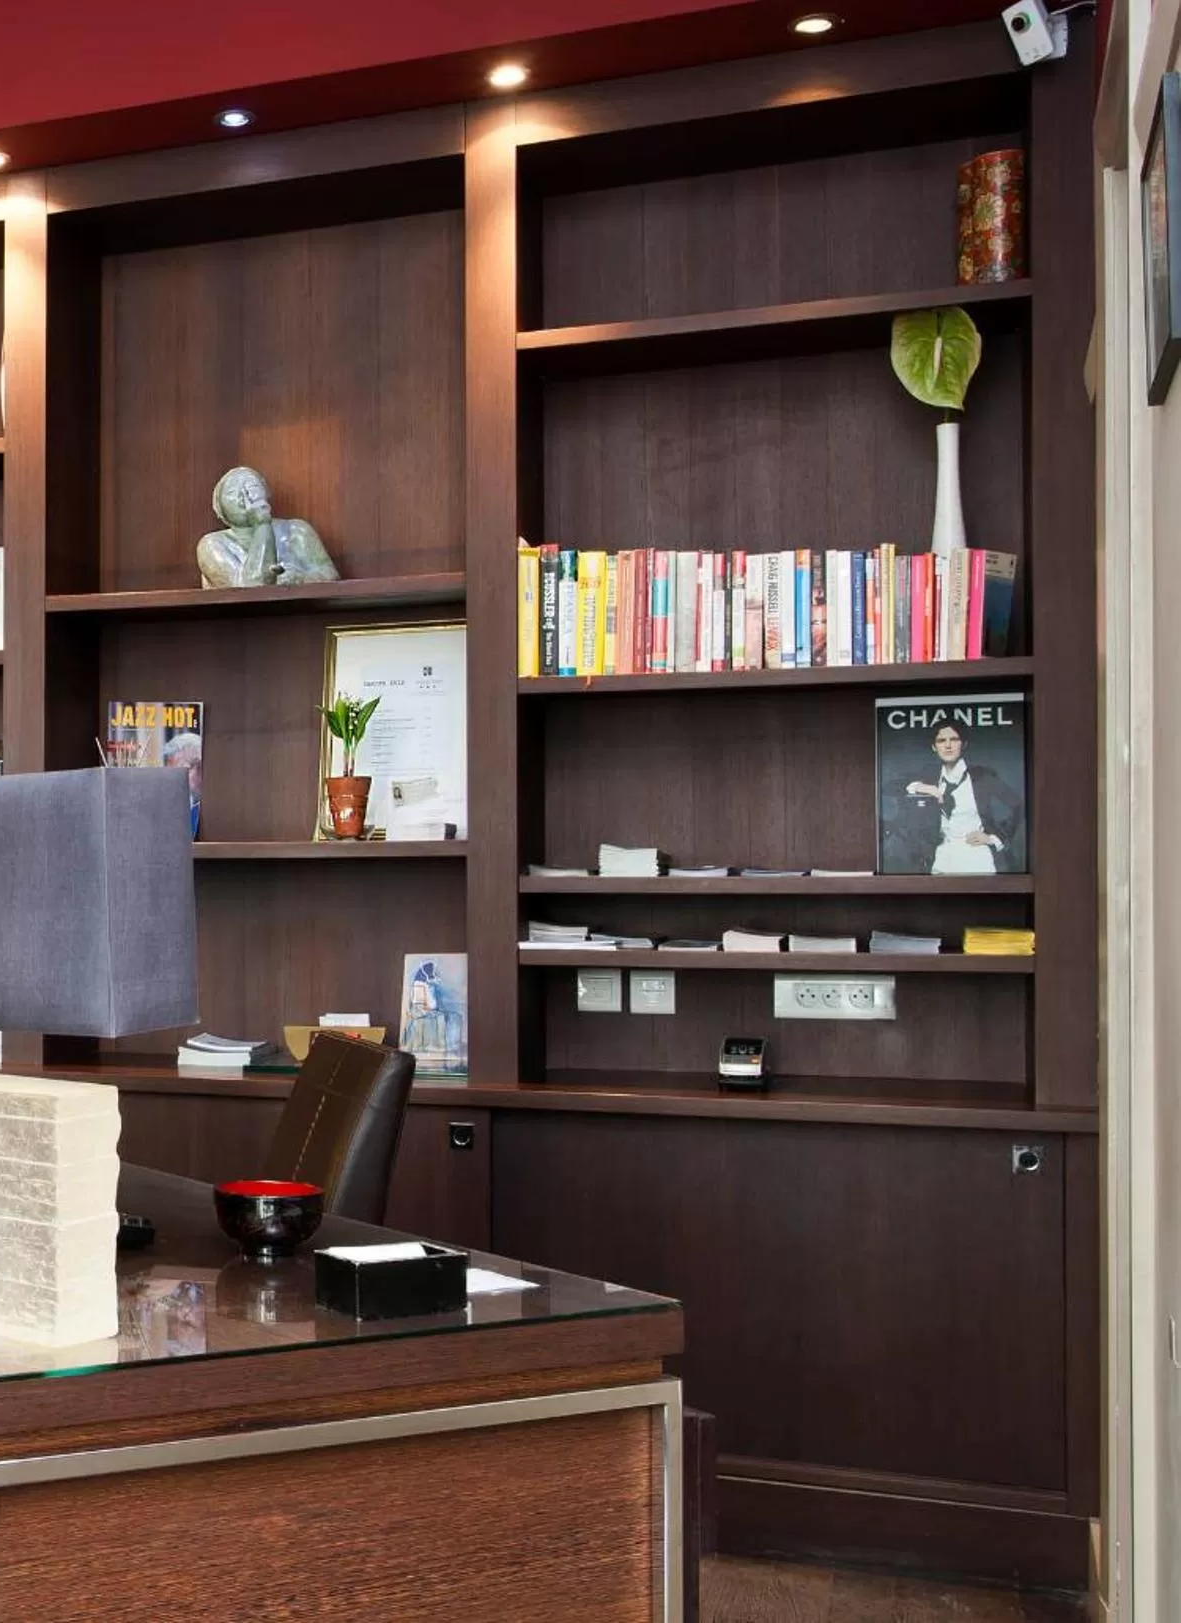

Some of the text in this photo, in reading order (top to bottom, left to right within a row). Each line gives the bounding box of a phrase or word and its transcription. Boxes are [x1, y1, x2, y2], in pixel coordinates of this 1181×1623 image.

[111, 704, 194, 728] JAZZ HOT
[887, 707, 1013, 729] CHANEL
